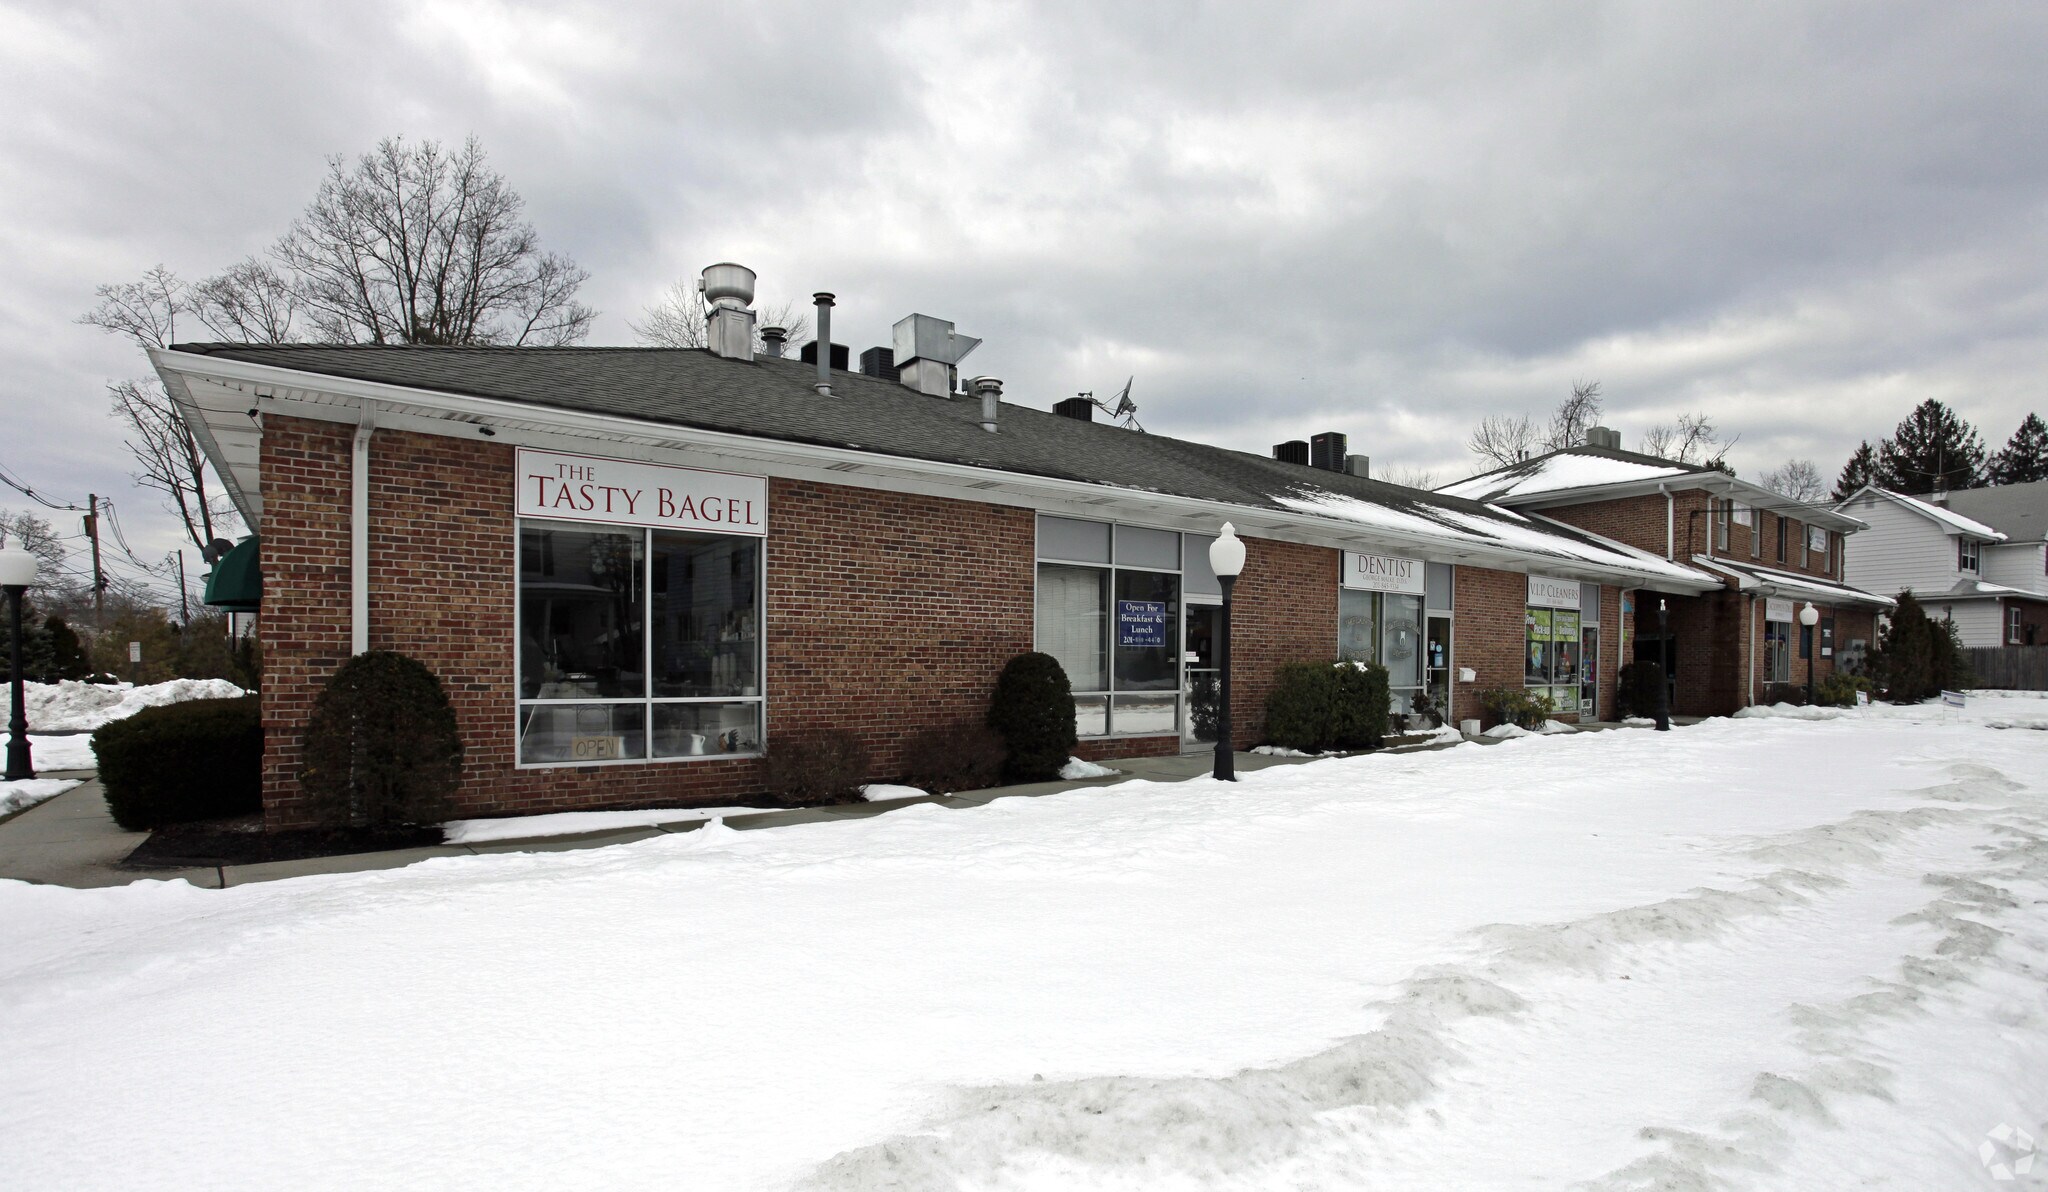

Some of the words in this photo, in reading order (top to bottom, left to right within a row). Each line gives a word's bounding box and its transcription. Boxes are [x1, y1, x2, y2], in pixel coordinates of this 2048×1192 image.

[555, 463, 595, 482] THE
[528, 474, 643, 515] TASTY
[657, 487, 759, 526] BAGEL
[1358, 554, 1414, 578] DENTIST
[1547, 584, 1579, 600] CLEANERS
[1125, 602, 1145, 613] Open
[1147, 603, 1158, 612] For
[1121, 613, 1153, 623] Breakfast
[1155, 614, 1163, 623] &
[1131, 625, 1153, 634] Lunch
[576, 739, 615, 757] OPEN
